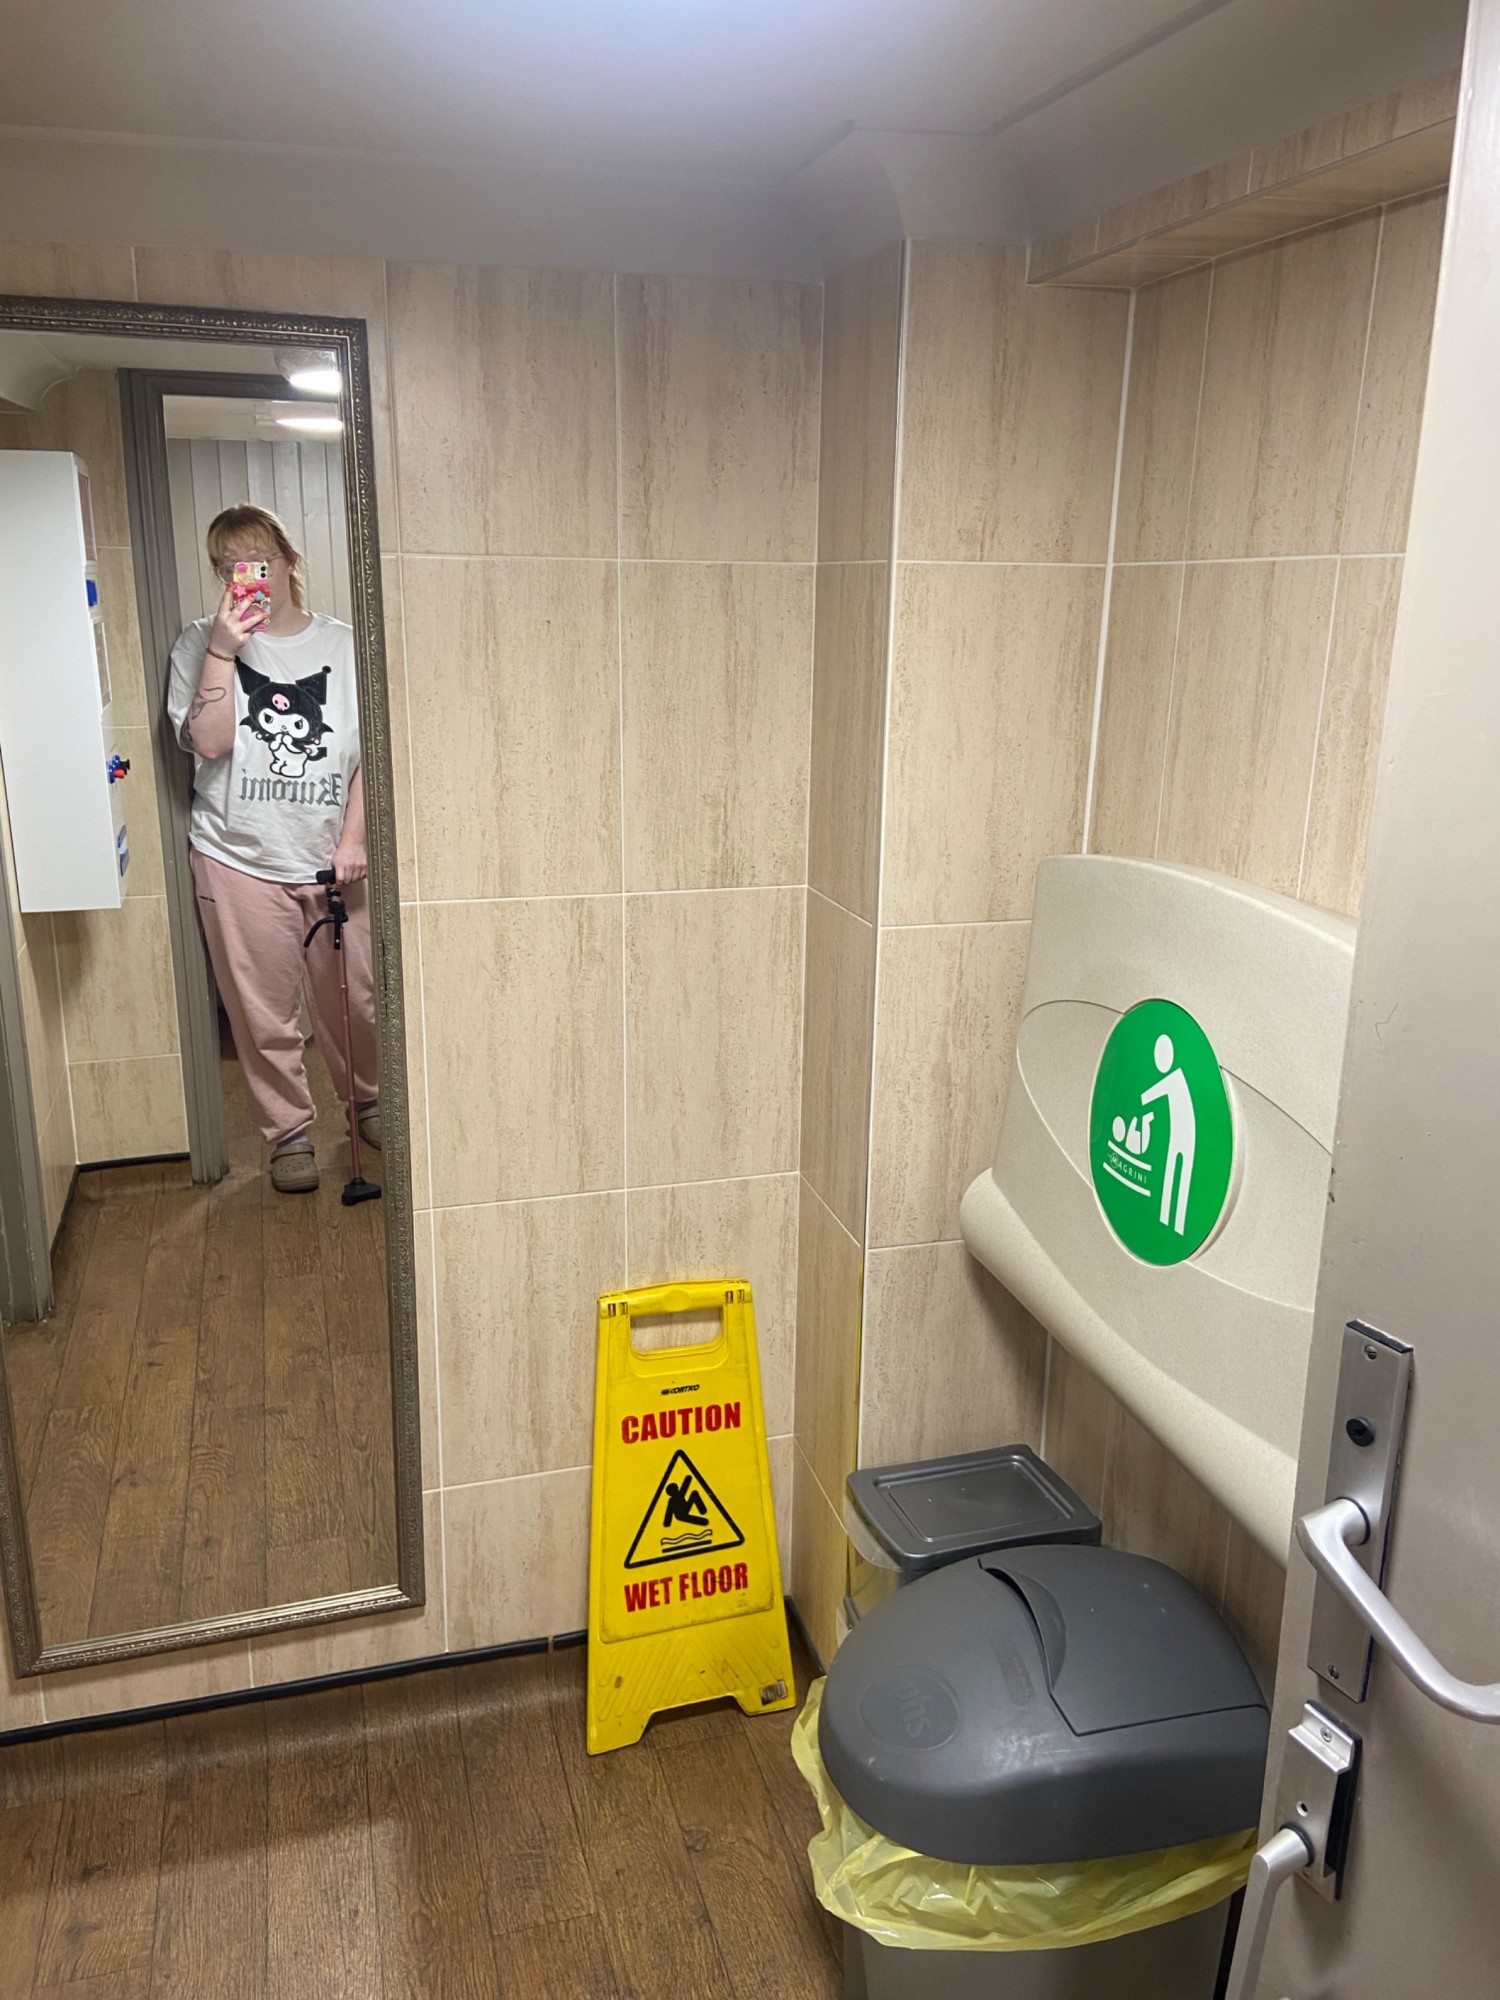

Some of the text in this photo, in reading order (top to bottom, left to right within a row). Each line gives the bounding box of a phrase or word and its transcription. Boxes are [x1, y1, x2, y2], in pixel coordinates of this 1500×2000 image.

[1110, 1153, 1147, 1184] MAGRINI
[621, 1401, 741, 1444] CAUTION
[624, 1562, 748, 1613] WET FLOOR
